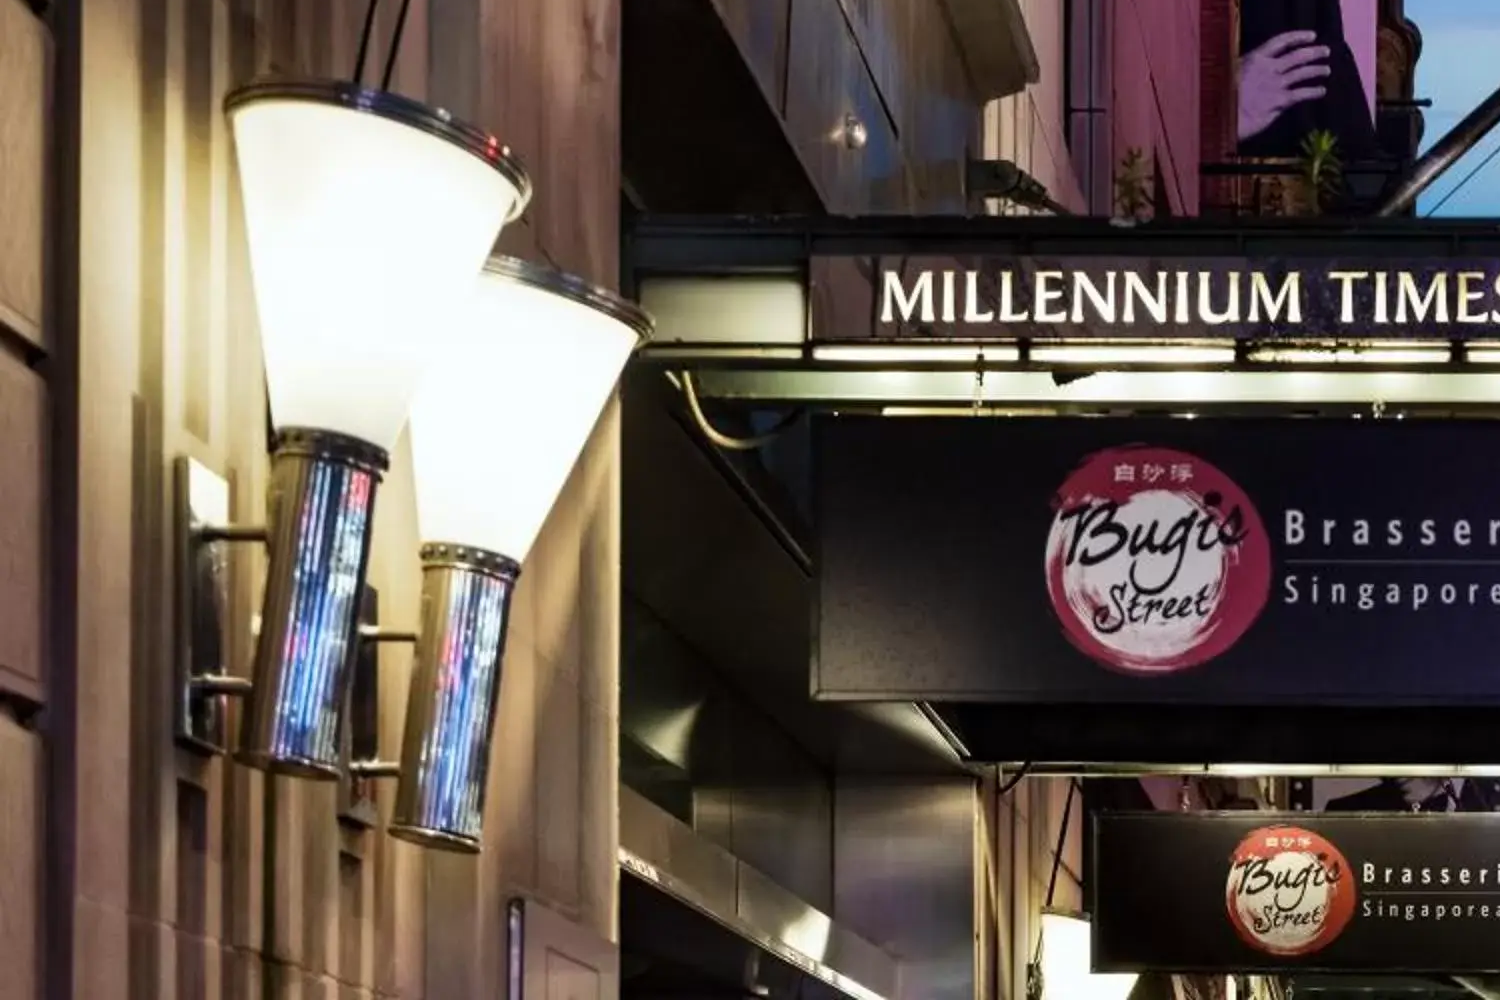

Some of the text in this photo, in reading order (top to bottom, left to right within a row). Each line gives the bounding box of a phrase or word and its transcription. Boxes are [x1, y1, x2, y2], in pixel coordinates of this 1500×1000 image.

[880, 270, 1302, 324] MILLENNIUM
[1060, 491, 1249, 595] Bugis
[1093, 581, 1211, 634] Street
[1235, 852, 1342, 912] Bugis
[1253, 905, 1321, 934] Street
